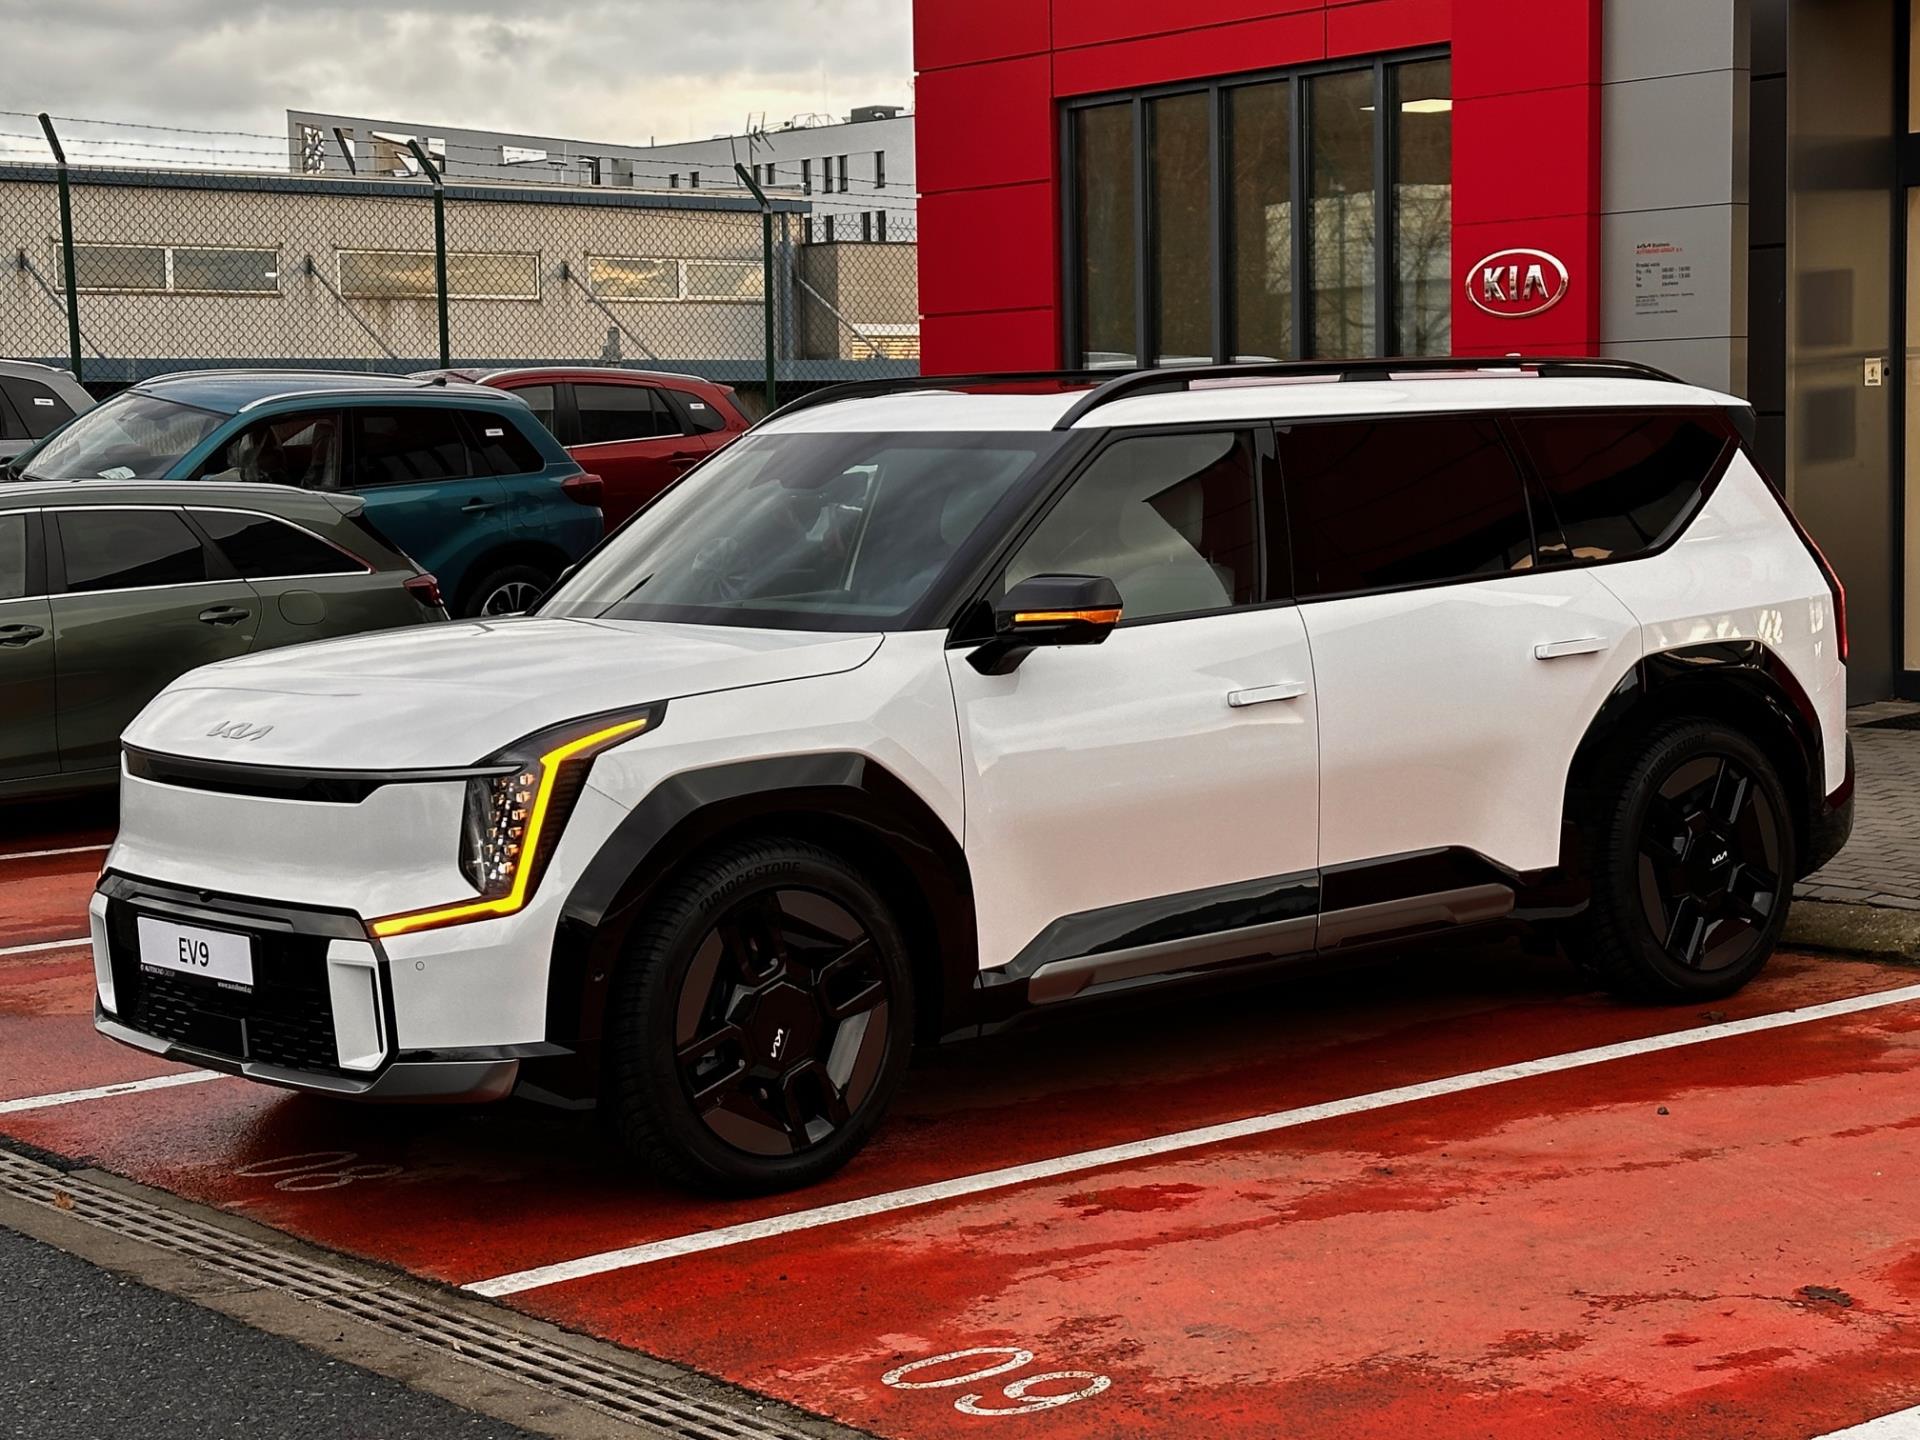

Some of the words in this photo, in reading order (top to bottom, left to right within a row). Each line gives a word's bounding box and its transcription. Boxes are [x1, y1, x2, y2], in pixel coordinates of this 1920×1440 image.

[1484, 264, 1549, 301] KIA
[205, 720, 275, 741] KIA
[178, 936, 209, 968] EV9
[881, 1346, 1112, 1416] 09
